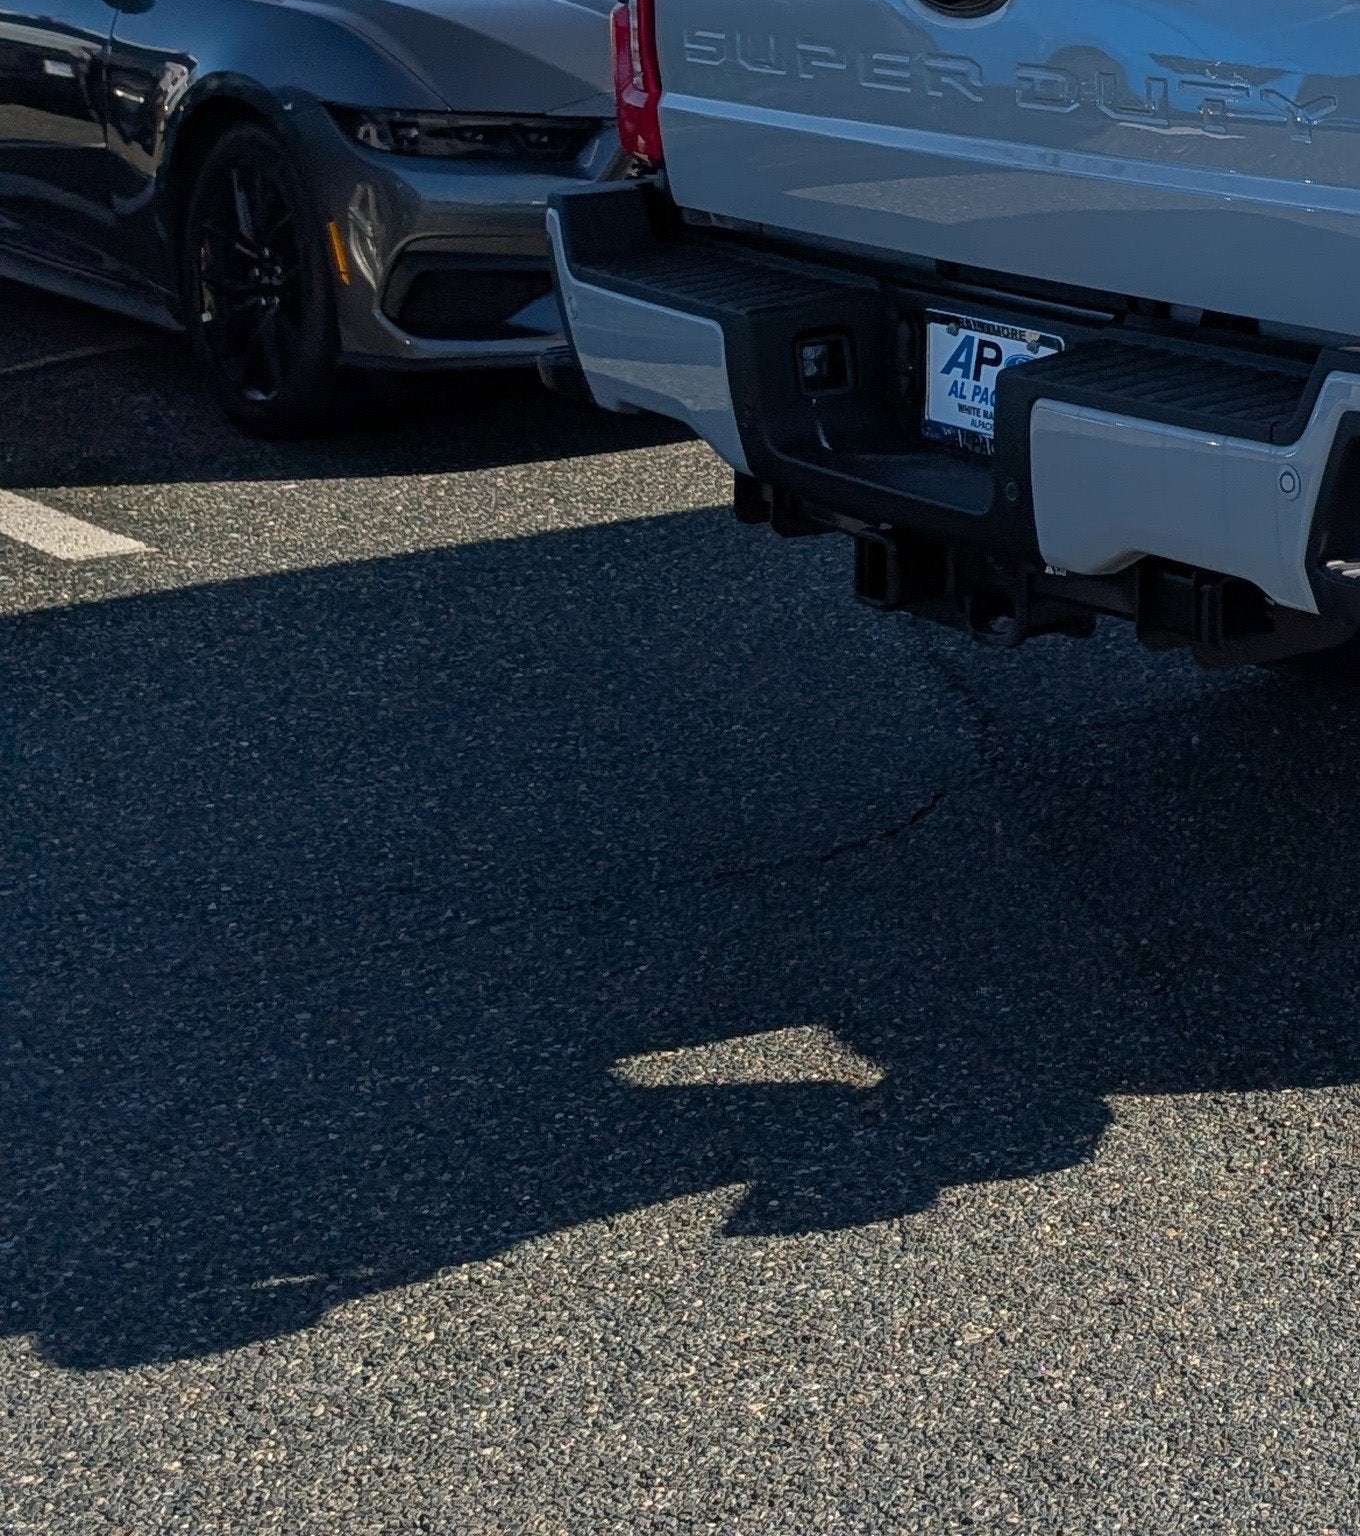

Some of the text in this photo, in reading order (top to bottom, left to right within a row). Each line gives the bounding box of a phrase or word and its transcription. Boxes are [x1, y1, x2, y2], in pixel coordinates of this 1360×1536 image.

[684, 29, 1337, 144] SUPER DUTY
[940, 334, 1003, 383] AP
[948, 379, 967, 401] AL
